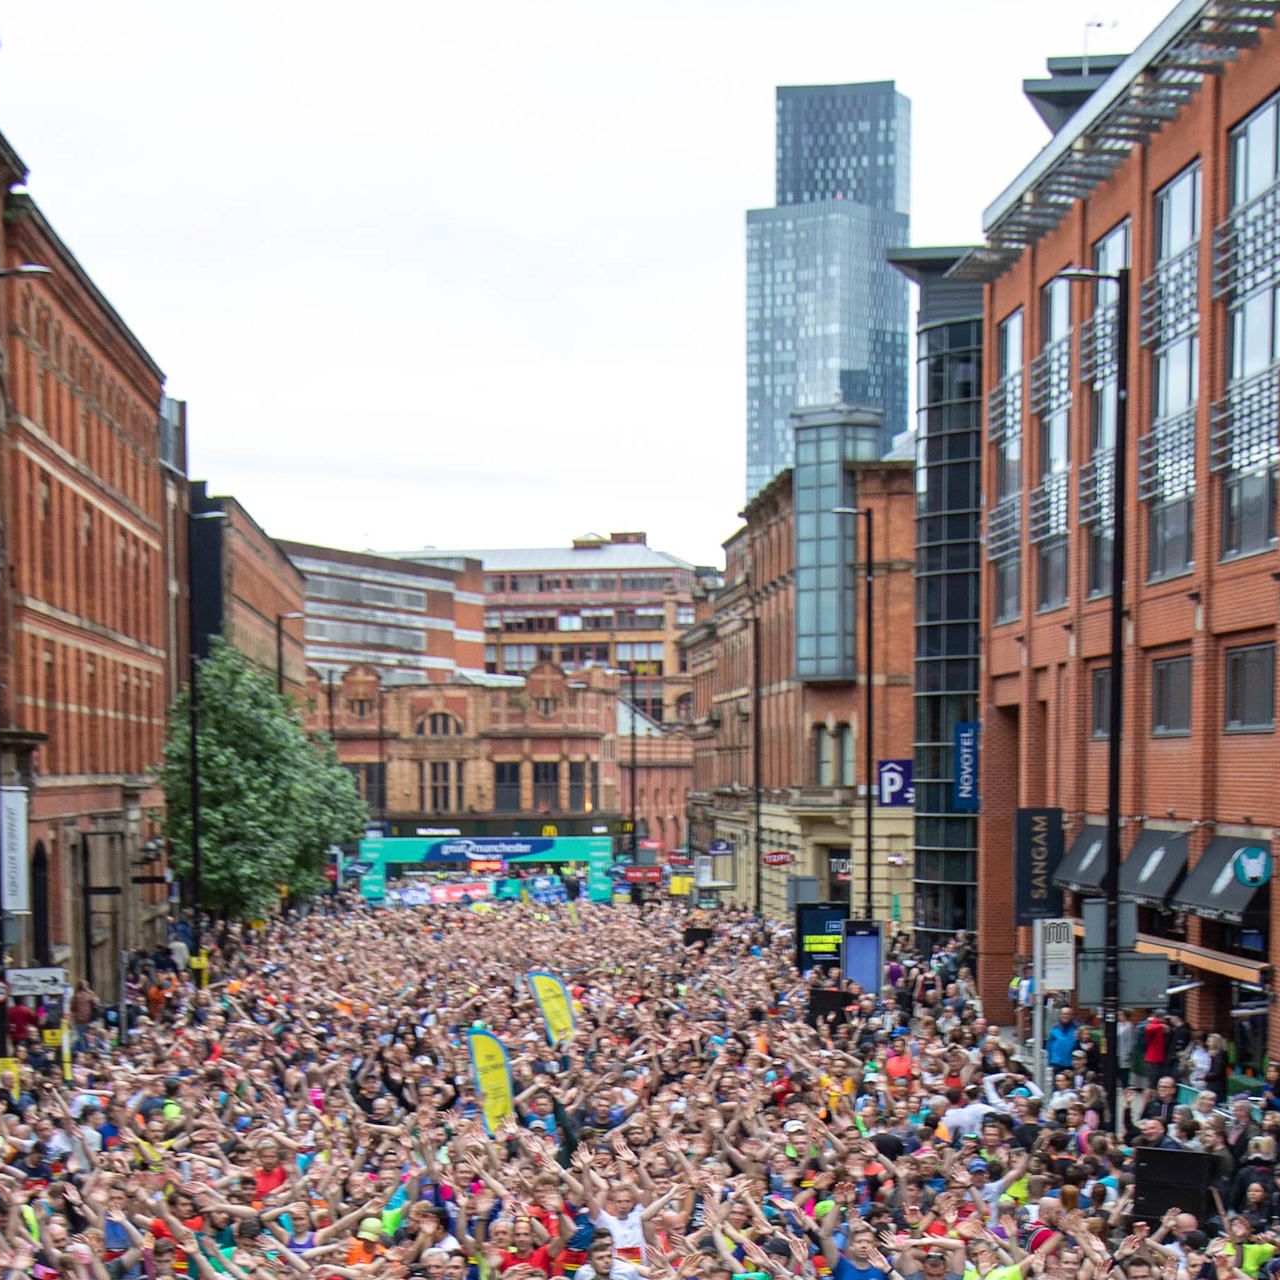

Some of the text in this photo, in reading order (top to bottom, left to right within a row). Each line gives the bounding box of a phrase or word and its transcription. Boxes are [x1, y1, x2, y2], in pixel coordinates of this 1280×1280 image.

[881, 771, 903, 804] P
[959, 728, 975, 799] NOVOTEL
[1031, 815, 1048, 899] SANGAM
